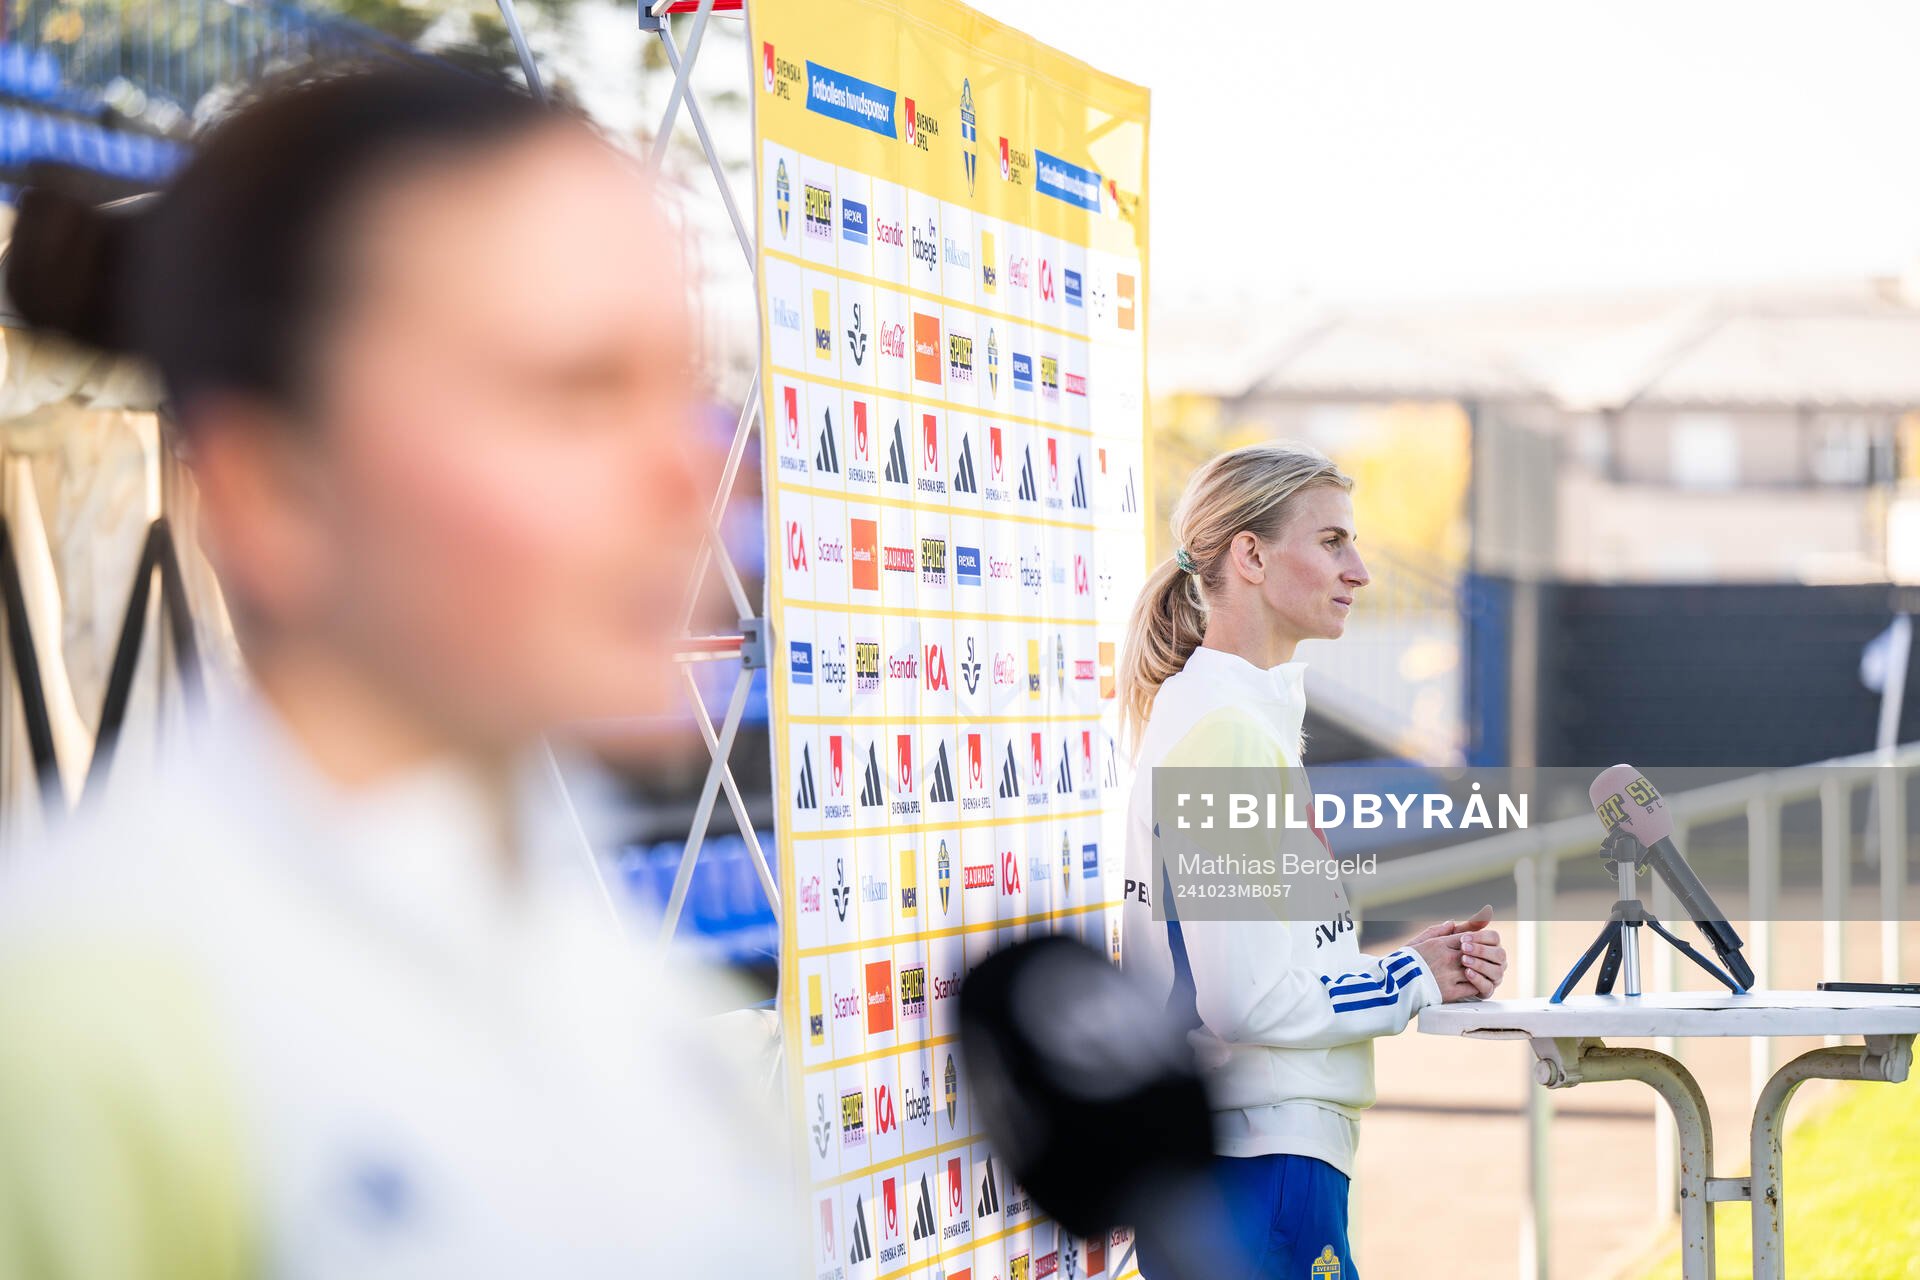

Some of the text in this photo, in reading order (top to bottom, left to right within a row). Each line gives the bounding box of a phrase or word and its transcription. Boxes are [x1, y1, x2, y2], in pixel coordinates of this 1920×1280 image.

[777, 58, 801, 83] SVENSKA
[777, 80, 791, 101] SPEL
[812, 75, 889, 123] Fotbollens huvudsponsor
[917, 112, 938, 136] SVENSKA
[917, 131, 928, 151] SPEL
[805, 184, 832, 226] SPORT
[877, 218, 904, 247] Scandic
[911, 225, 937, 271] Fabege
[1038, 258, 1055, 303] ICA
[853, 302, 862, 333] SJ
[949, 333, 973, 371] SPORT
[917, 477, 946, 494] SVENSKA SPEL
[787, 519, 808, 572] ICA
[884, 547, 915, 569] BAUHAUS
[921, 538, 946, 574] SPORT
[923, 573, 946, 584] BLADET
[855, 642, 879, 679] SPORT
[967, 636, 974, 664] SJ
[889, 653, 918, 680] Scandic
[925, 643, 949, 691] ICA
[857, 679, 879, 690] BLADET
[892, 800, 921, 815] SVENSKA SPEL
[962, 796, 991, 810] SVENSKA SPEL
[964, 865, 994, 887] BAUHAUS
[1001, 851, 1021, 896] ICA
[900, 967, 924, 1006] SPORT
[834, 987, 860, 1019] Scandic
[902, 1002, 925, 1017] BLADET
[841, 1091, 864, 1131] SPORT
[874, 1084, 896, 1135] ICA
[906, 1087, 931, 1126] Fabege
[943, 1219, 971, 1240] SVENSKA SPEL
[880, 1242, 907, 1264] SVENSKA SPEL
